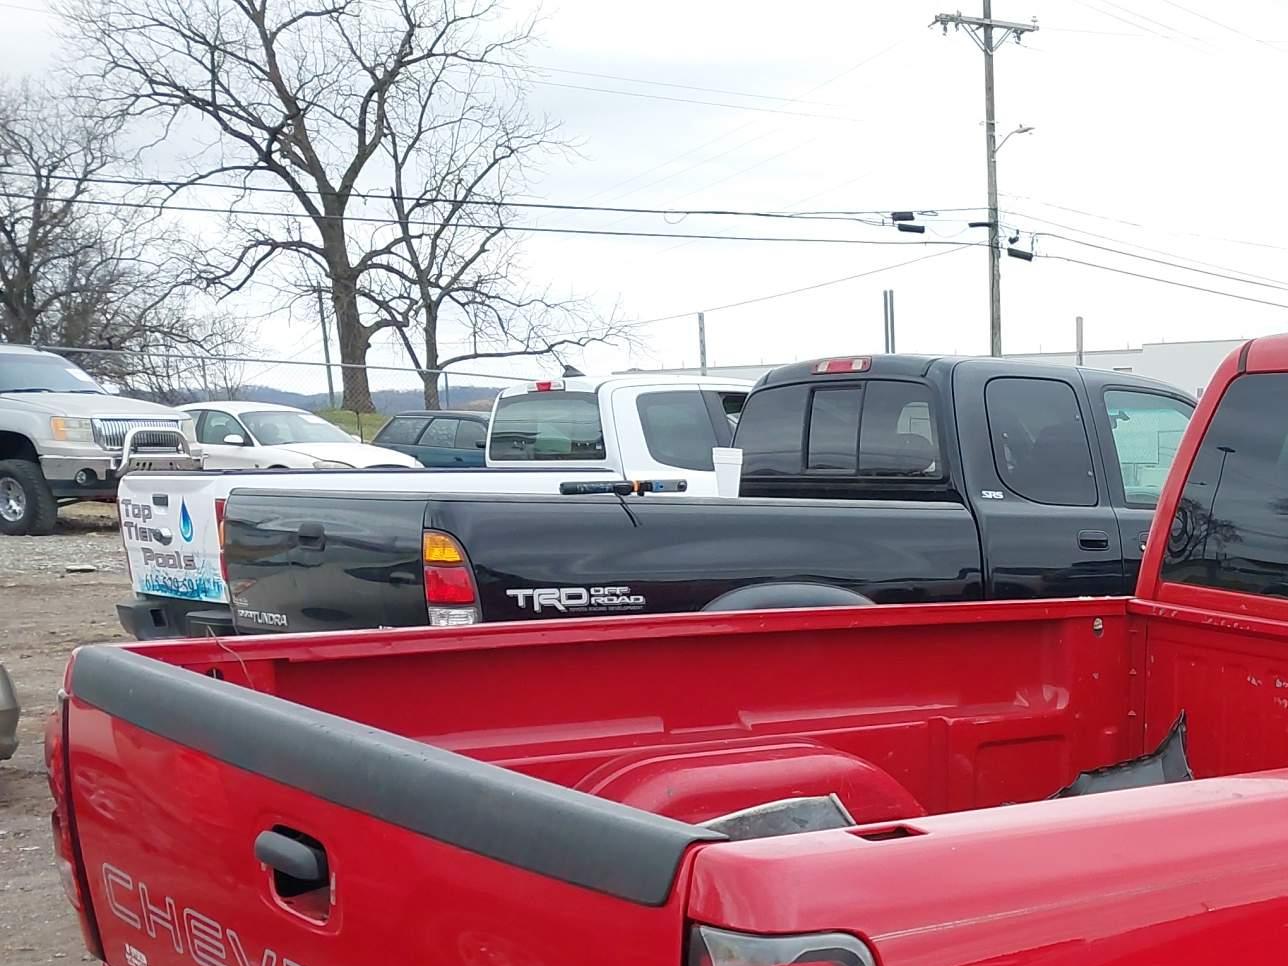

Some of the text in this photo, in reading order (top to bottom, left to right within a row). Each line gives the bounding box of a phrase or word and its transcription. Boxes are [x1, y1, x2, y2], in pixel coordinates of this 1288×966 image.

[122, 499, 152, 523] Top
[142, 547, 197, 571] Pools
[506, 587, 590, 613] TRD
[590, 586, 631, 596] OFF
[590, 595, 646, 606] ROAD
[252, 611, 288, 626] TUNDRA
